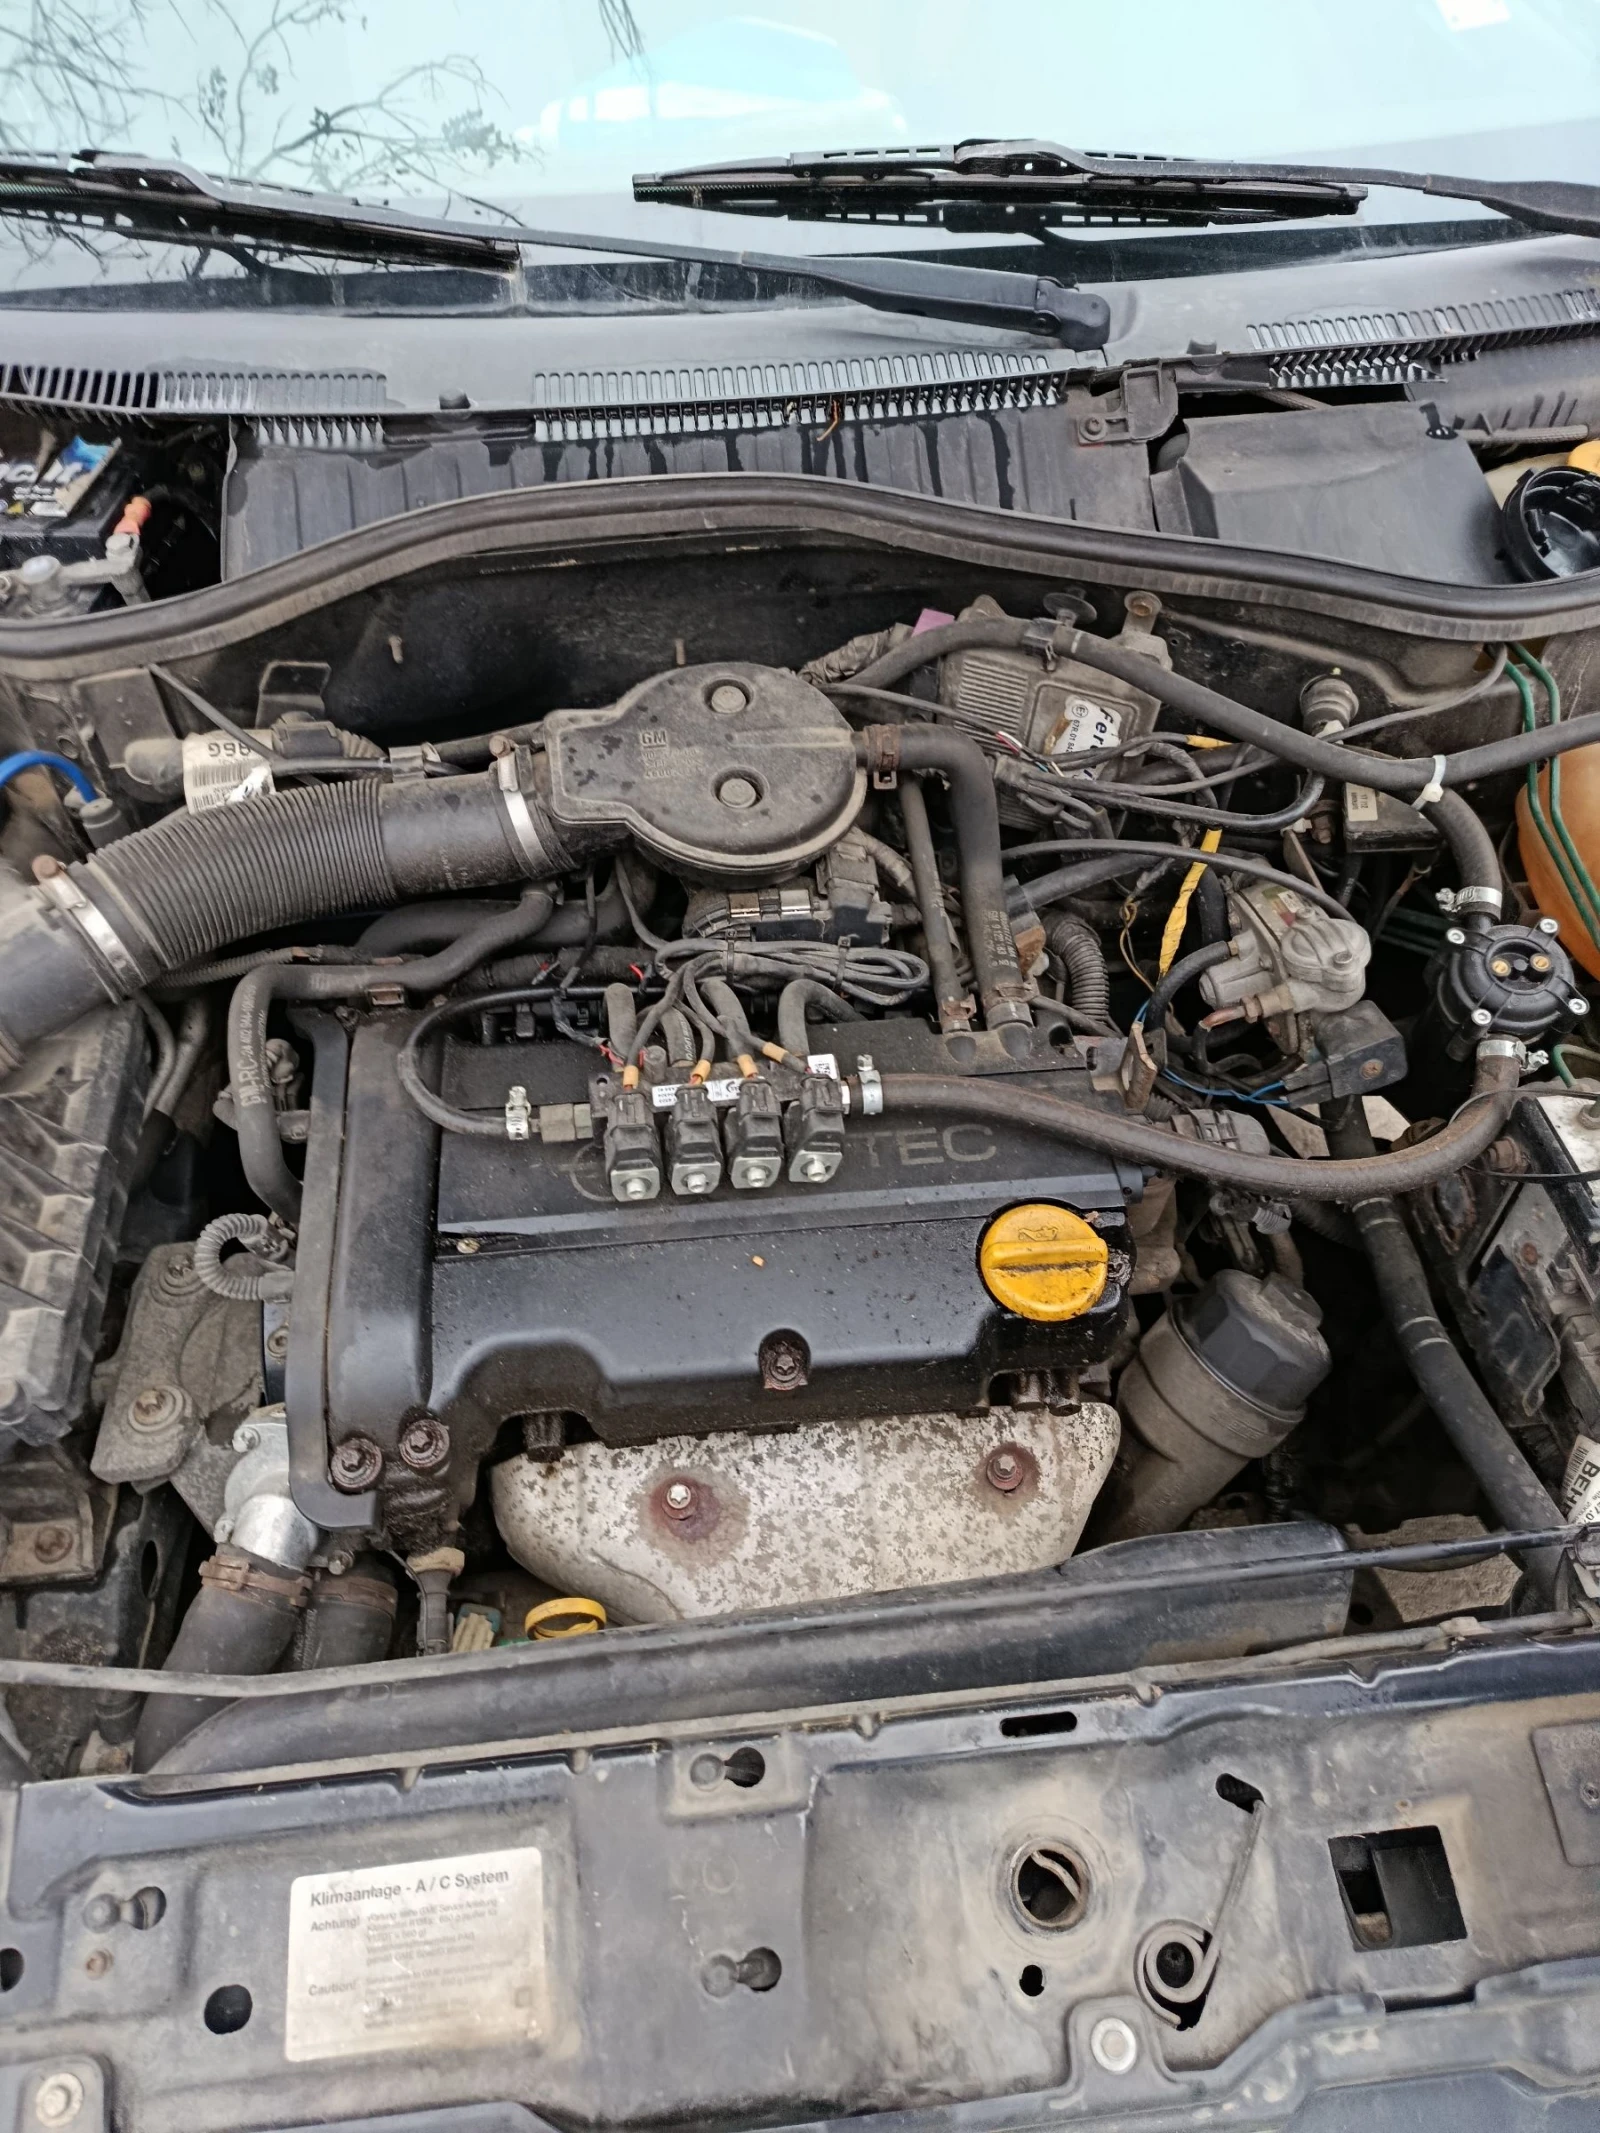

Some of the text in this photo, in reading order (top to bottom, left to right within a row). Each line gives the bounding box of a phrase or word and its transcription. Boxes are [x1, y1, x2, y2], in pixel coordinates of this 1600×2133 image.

[641, 730, 667, 745] GM
[310, 1884, 401, 1907] Klimaanlage
[415, 1879, 427, 1894] A
[439, 1875, 450, 1890] C
[455, 1870, 509, 1889] System
[310, 1916, 360, 1932] Achtung!
[308, 1981, 357, 1996] Caution!
